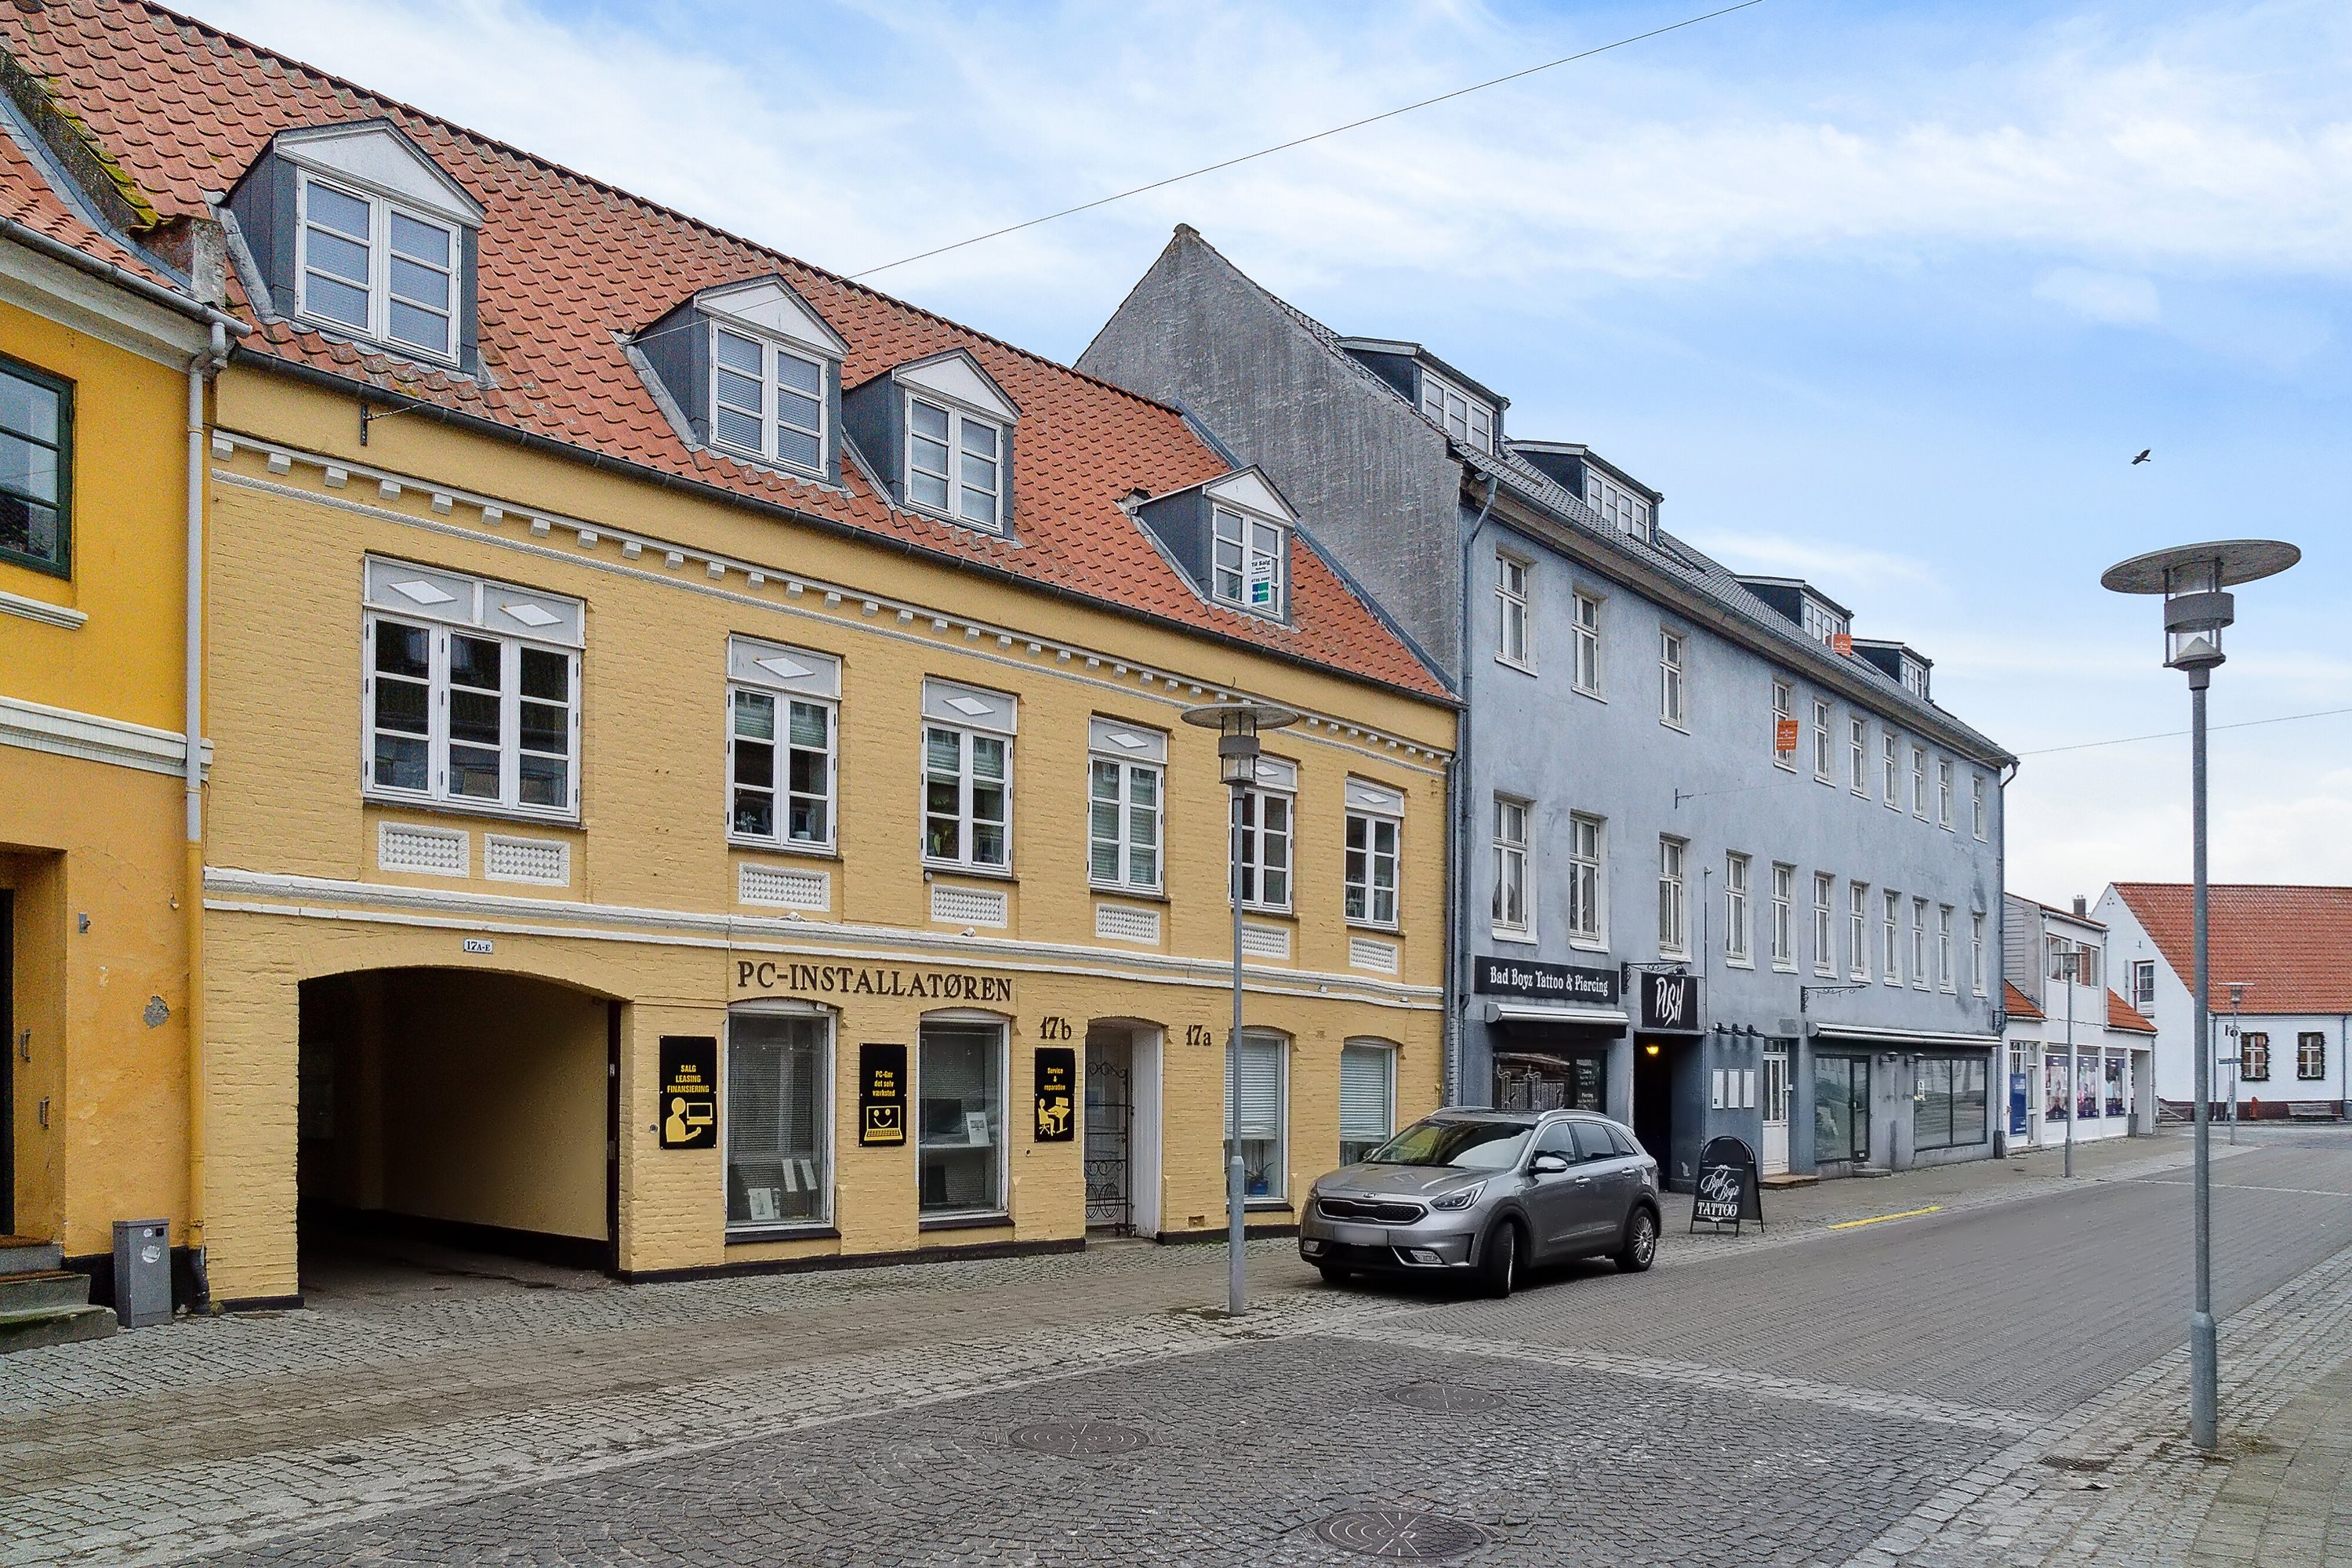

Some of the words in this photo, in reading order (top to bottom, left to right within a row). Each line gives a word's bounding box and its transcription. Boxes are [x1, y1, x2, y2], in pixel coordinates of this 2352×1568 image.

[466, 941, 491, 952] 17A-E
[737, 960, 1012, 1002] PC-INSTALLATØREN
[1490, 966, 1508, 985] Bad
[1511, 967, 1533, 990] Boyz
[1535, 970, 1564, 989] Tattoo
[1566, 974, 1573, 991] &
[1574, 975, 1608, 996] Piercing
[1040, 1016, 1072, 1040] 17b
[1186, 1025, 1211, 1046] 17a
[1700, 1169, 1729, 1193] Bad
[1712, 1178, 1740, 1203] Boyz
[1697, 1202, 1737, 1217] TATTOO
